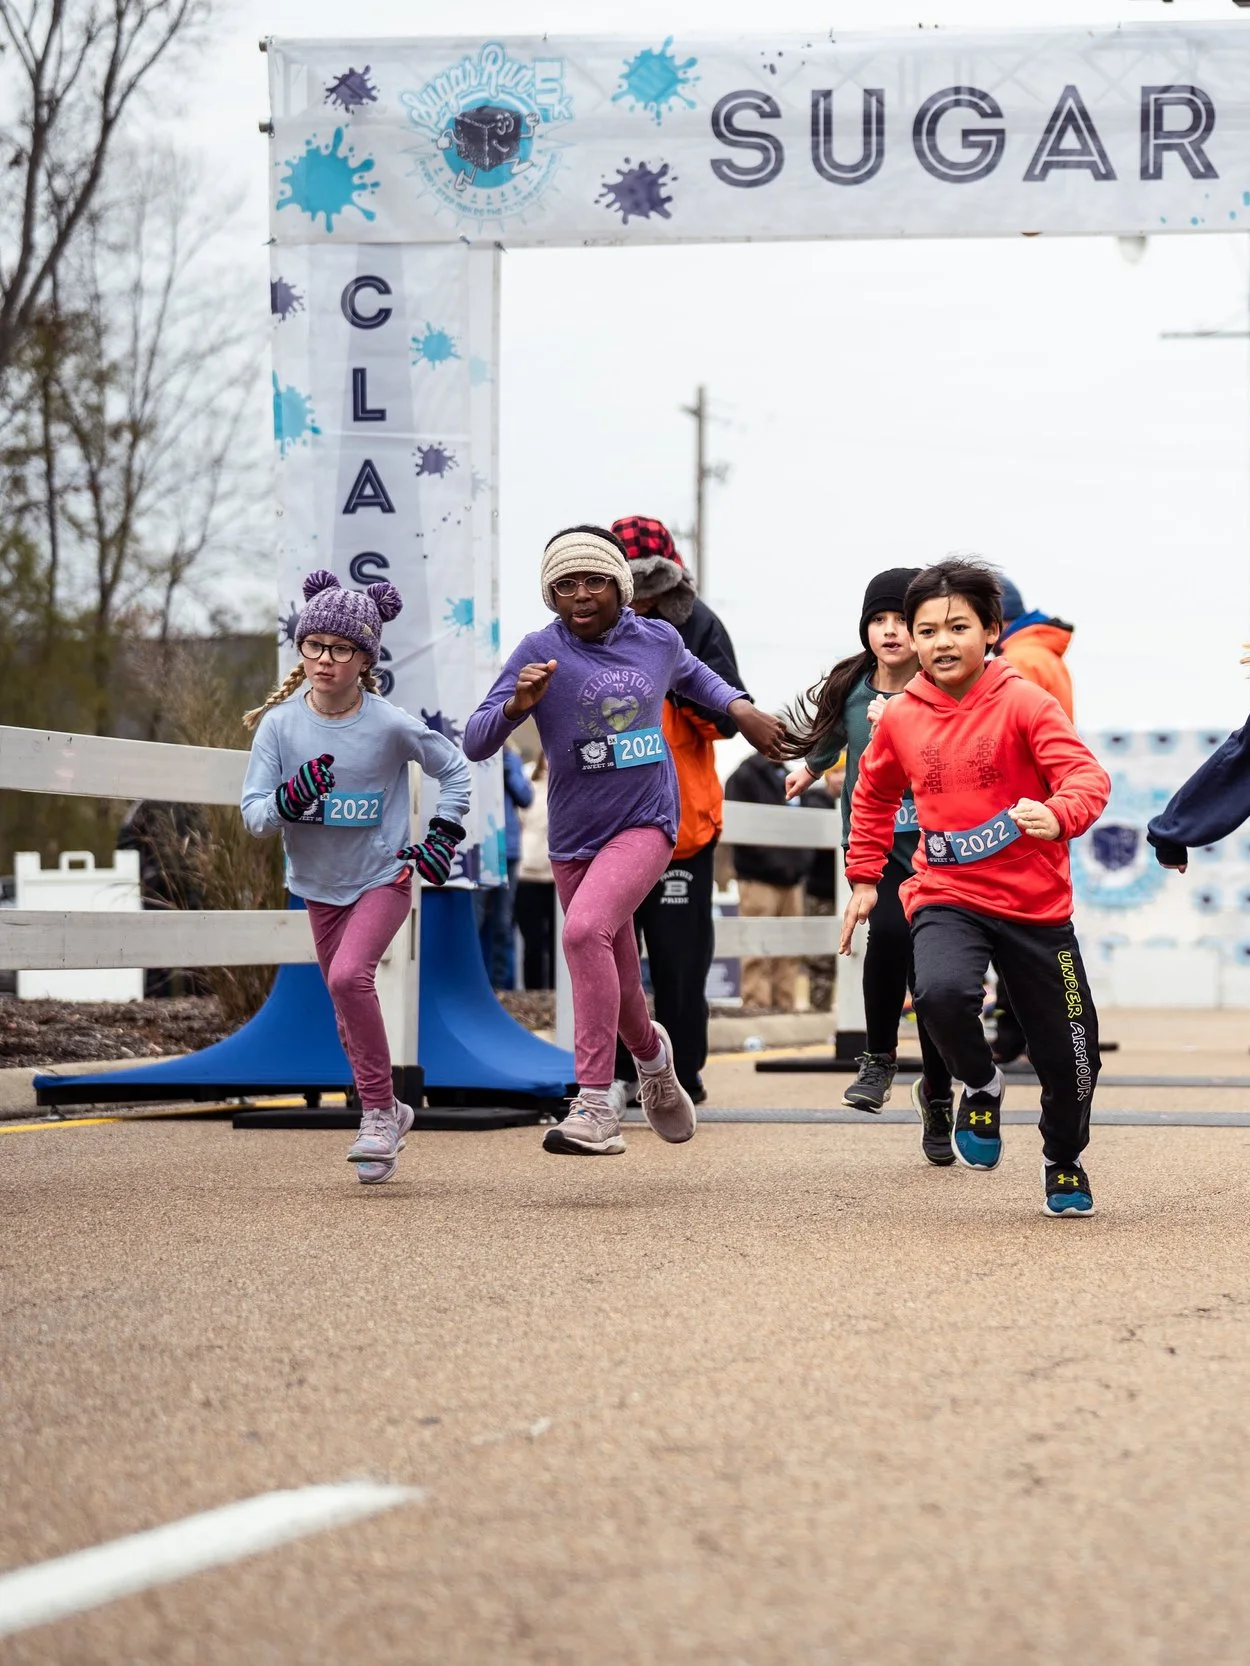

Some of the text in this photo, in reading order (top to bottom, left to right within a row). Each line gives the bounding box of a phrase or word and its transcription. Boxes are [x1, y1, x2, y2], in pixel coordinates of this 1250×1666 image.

[401, 57, 481, 134] Sugar
[480, 42, 535, 99] Run
[710, 85, 1220, 188] SUGAR
[619, 733, 663, 761] 2022
[330, 798, 379, 820] 2022
[955, 820, 1010, 857] 2022
[660, 869, 694, 882] PANTHER
[664, 880, 688, 896] B
[1058, 951, 1083, 1019] UNDER
[1070, 1021, 1091, 1102] ARMOUR
